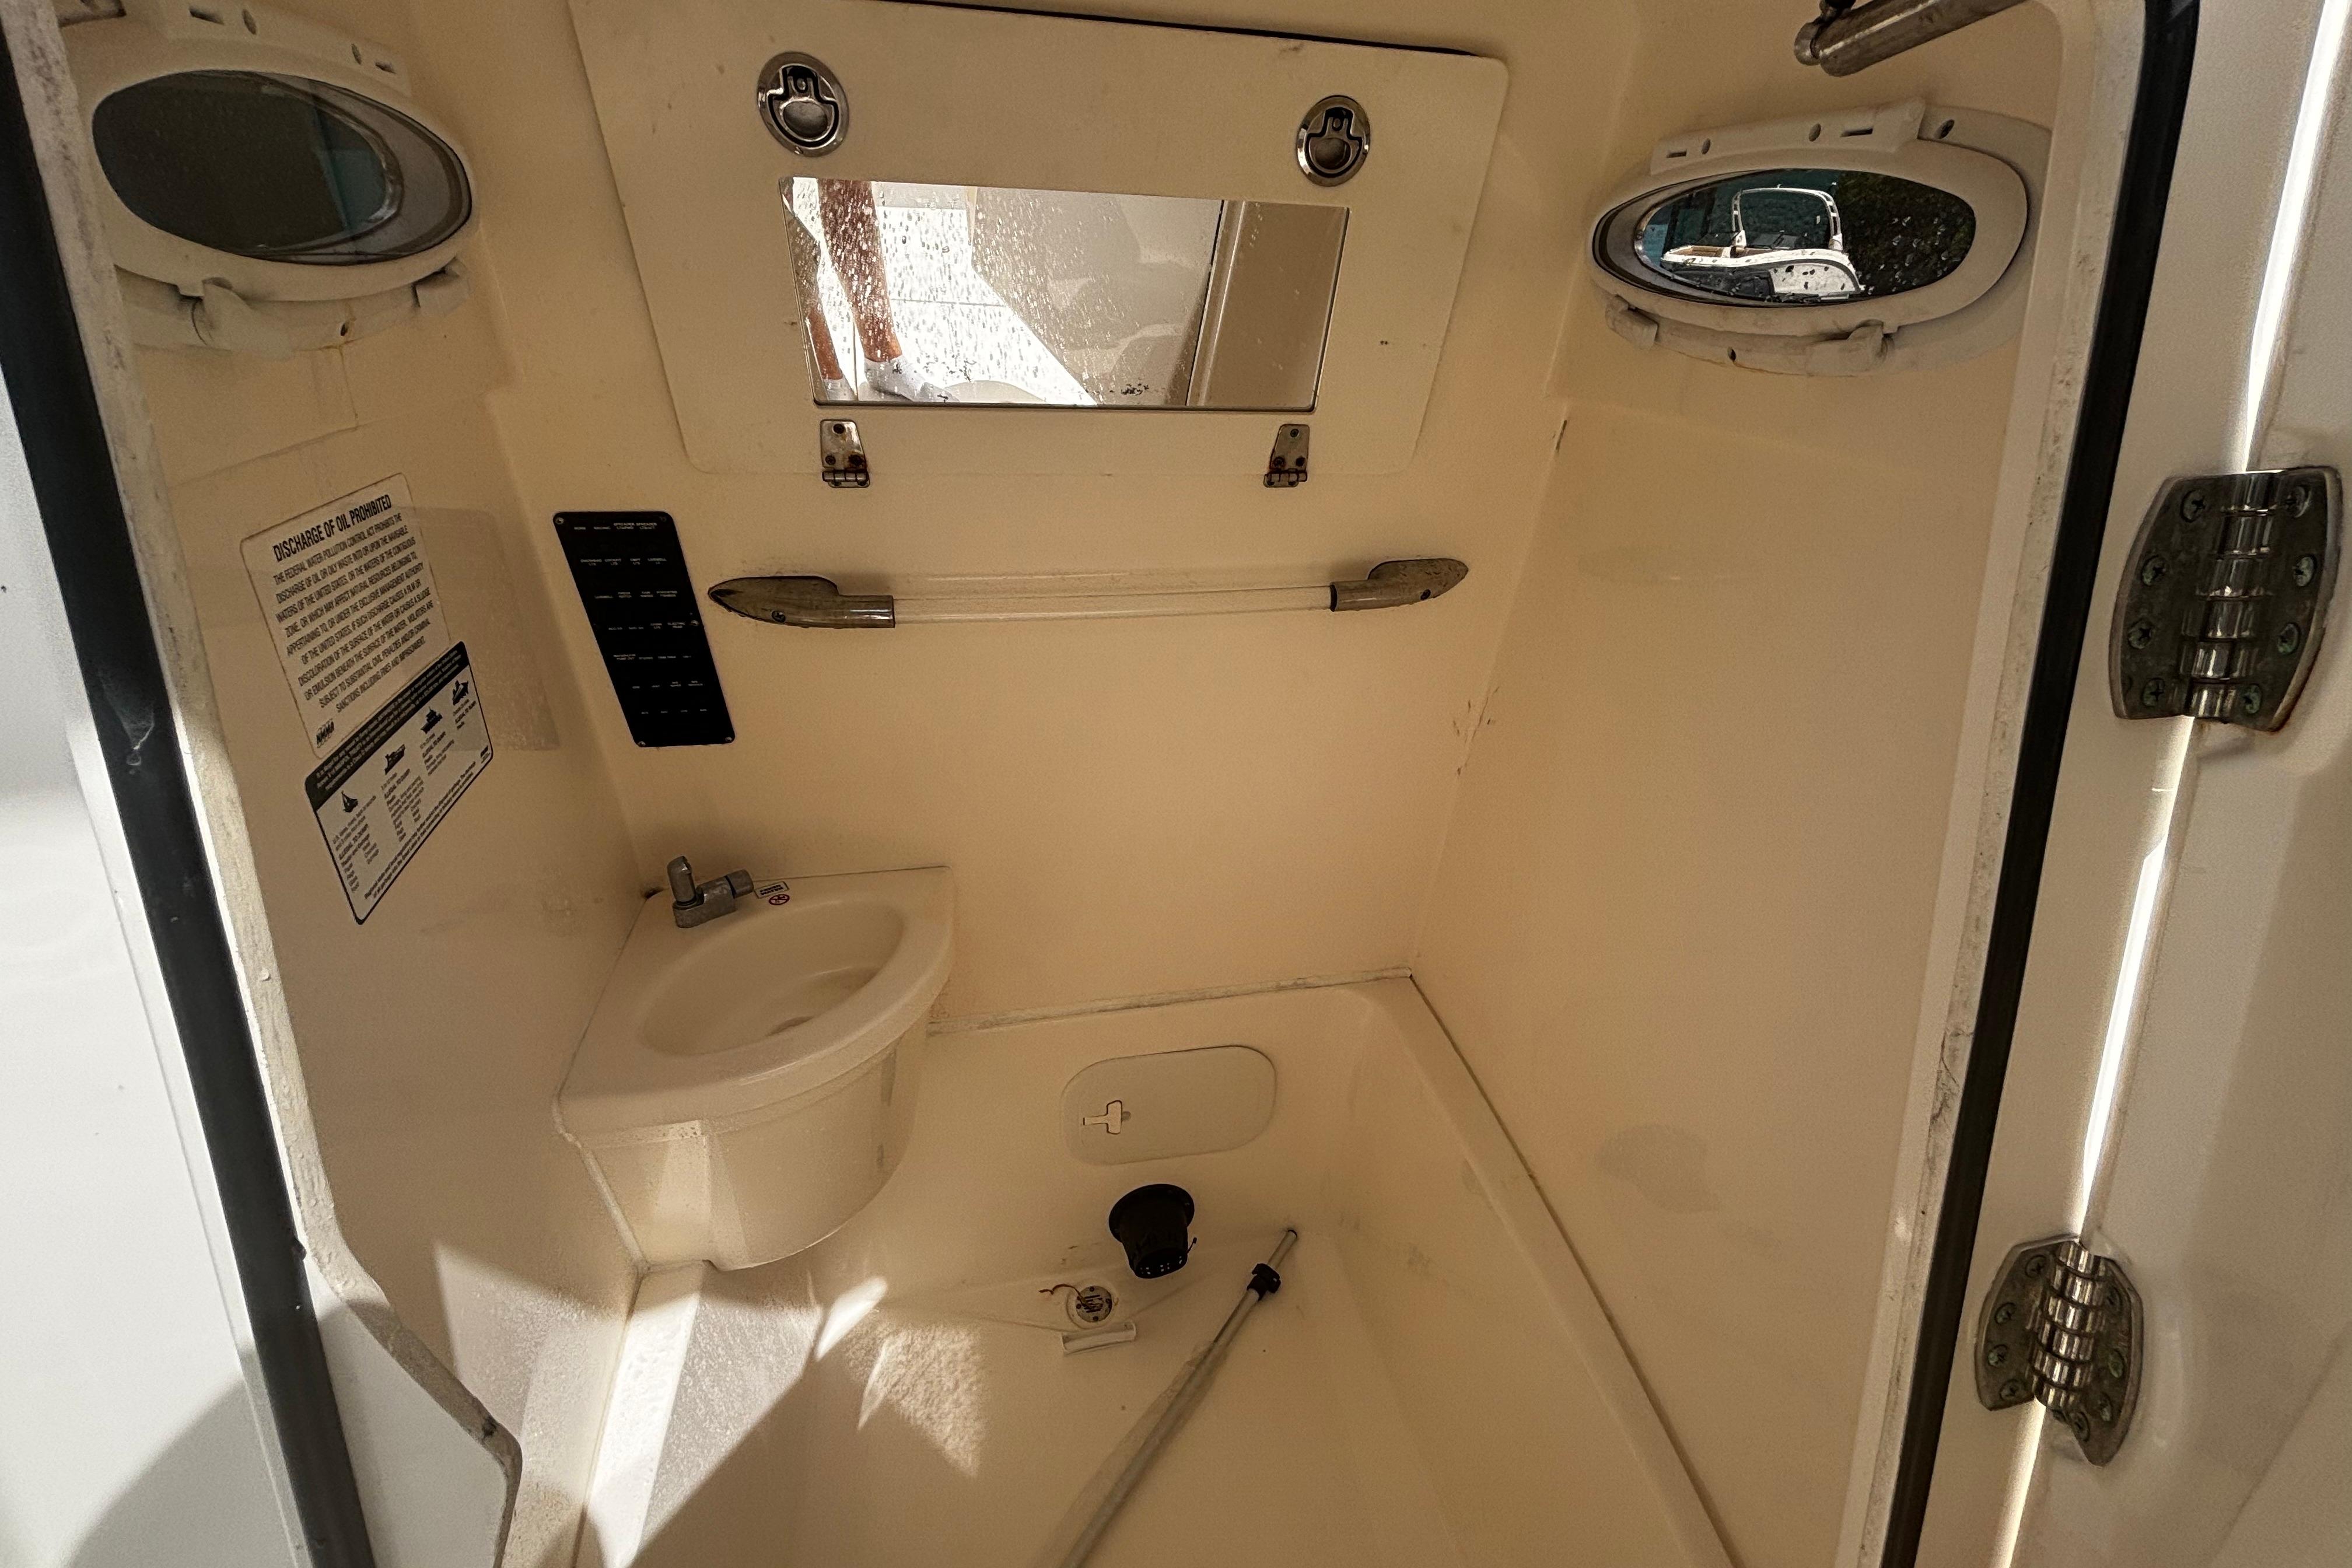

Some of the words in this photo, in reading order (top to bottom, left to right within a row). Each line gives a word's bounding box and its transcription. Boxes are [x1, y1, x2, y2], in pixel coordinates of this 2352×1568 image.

[272, 524, 325, 562] DISCHARGE
[323, 519, 337, 538] OF
[335, 512, 351, 533] OIL
[349, 494, 392, 526] PROHIBITED
[272, 571, 285, 586] THE
[284, 560, 307, 580] FEDERAL
[306, 551, 324, 569] WATER
[322, 540, 348, 561] POLLUTION
[346, 530, 368, 548] CONTROL
[366, 526, 375, 538] ACT
[373, 516, 395, 534] PROHIBITS
[393, 512, 402, 524] THE
[274, 603, 298, 624] WATERS
[296, 598, 306, 611] OF
[304, 593, 315, 607] THE
[313, 583, 332, 601] UNITED
[348, 570, 355, 582] OR
[354, 565, 365, 578] THE
[362, 555, 380, 573] WATERS
[379, 552, 386, 564] OF
[384, 548, 393, 561] THE
[275, 579, 306, 604] DISCHARGE
[304, 576, 313, 588] OF
[312, 571, 321, 584] OIL
[320, 567, 328, 580] OR
[327, 562, 338, 576] OILY
[337, 554, 354, 570] WASTE
[351, 548, 363, 562] INTO
[362, 545, 369, 556] OR
[368, 539, 381, 553] UPON
[379, 535, 388, 547] THE
[299, 615, 310, 629] OR
[307, 606, 325, 624] WHICH
[323, 599, 335, 614] MAY
[333, 590, 351, 608] AFFECT
[349, 579, 369, 598] NATURAL
[368, 565, 392, 587] RESOURCES
[285, 626, 321, 656] APPERTAINING
[327, 617, 337, 629] OR
[334, 607, 351, 625] UNDER
[349, 601, 360, 615] THE
[358, 588, 380, 610] EXCLUSIVE
[379, 572, 405, 596] MANAGEMENT
[404, 561, 424, 580] AUTHORITY
[298, 653, 335, 687] DISCOLORATION
[333, 649, 341, 662] OF
[340, 643, 350, 657] THE
[348, 629, 369, 650] SURFACE
[367, 626, 374, 638] OF
[373, 620, 382, 634] THE
[381, 611, 395, 628] WATER
[393, 607, 401, 619] OR
[413, 595, 418, 605] A
[300, 652, 310, 666] OF
[308, 645, 319, 660] THE
[317, 635, 336, 654] UNITED
[351, 620, 357, 632] IF
[355, 613, 368, 628] SUCH
[366, 598, 390, 621] DISCHARGE
[388, 589, 404, 606] CAUSES
[403, 587, 408, 596] A
[415, 578, 422, 589] OR
[303, 687, 313, 701] OR
[312, 670, 337, 695] EMULSION
[335, 656, 355, 678] BENEATH
[354, 650, 364, 664] THE
[362, 637, 382, 658] SURFACE
[380, 633, 387, 645] OF
[385, 628, 394, 640] THE
[425, 599, 433, 611] ARE
[318, 685, 340, 709] SUBJECT
[338, 680, 346, 694] TO
[345, 660, 373, 688] SUBSTANTIAL
[335, 687, 360, 713] SANCTIONS
[359, 670, 381, 694] INCLUDING
[379, 662, 392, 677] FINES
[390, 655, 400, 668] AND
[761, 887, 783, 895] WATER
